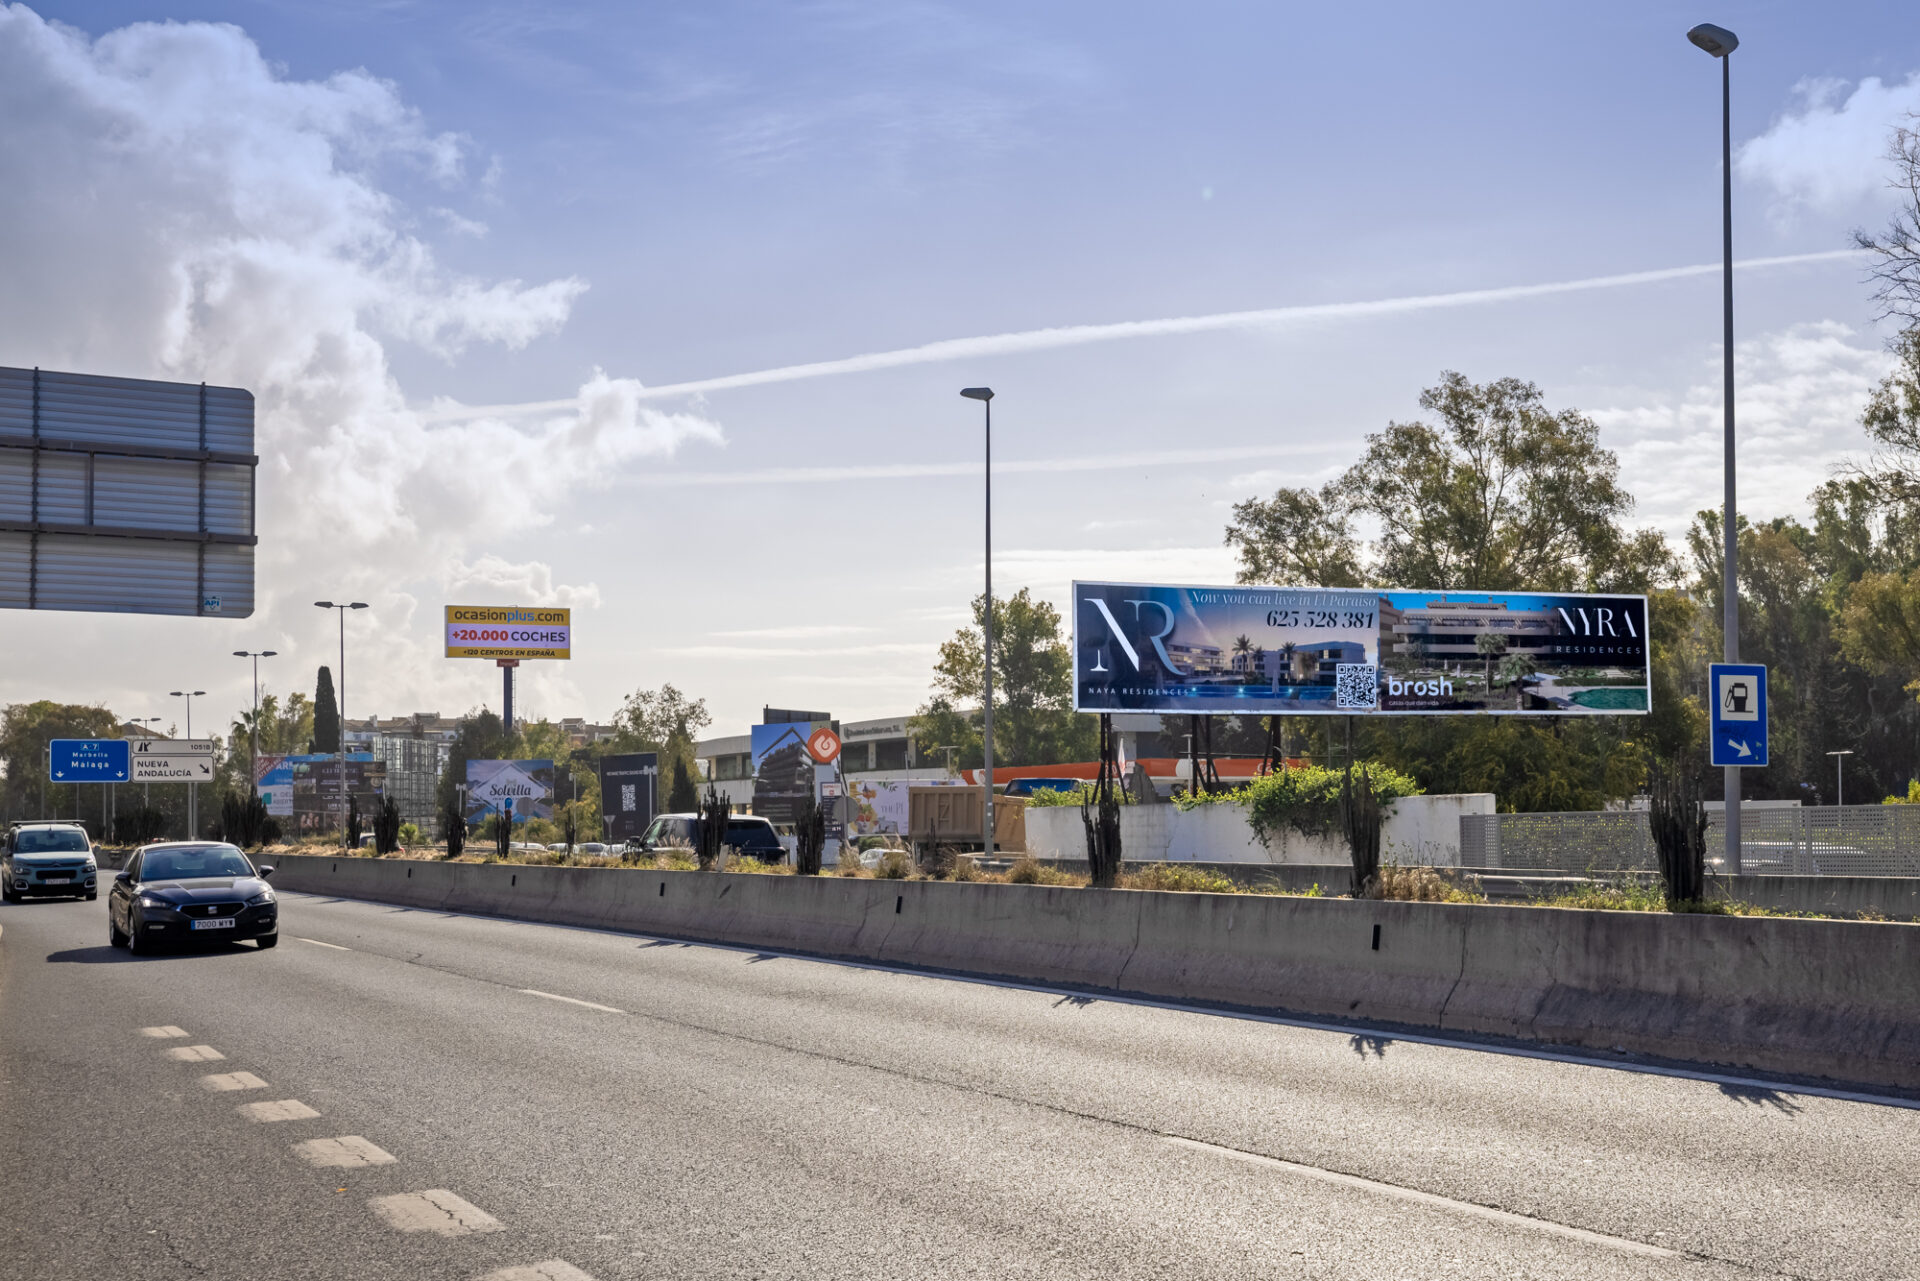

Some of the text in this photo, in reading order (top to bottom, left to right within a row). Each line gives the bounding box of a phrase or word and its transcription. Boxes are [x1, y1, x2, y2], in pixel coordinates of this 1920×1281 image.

[1192, 591, 1220, 603] Now
[1222, 593, 1245, 607] you
[1249, 594, 1271, 605] can
[1275, 592, 1296, 606] live
[1299, 593, 1312, 606] in
[1314, 594, 1326, 607] El
[454, 608, 564, 623] ocasionplus.com
[1266, 610, 1375, 630] 625 528 381
[1557, 607, 1638, 638] NYRA
[452, 629, 566, 642] +20.000 COCHES
[527, 648, 556, 657] ESPAÑA
[1556, 646, 1641, 655] RESIDENCES
[1088, 687, 1189, 697] NAYA RESIDENCES
[1388, 675, 1453, 696] brosh
[137, 760, 169, 768] NUEVA
[137, 768, 192, 777] ANDALUCÍA
[489, 783, 532, 796] Solvilla
[196, 920, 217, 928] 7000
